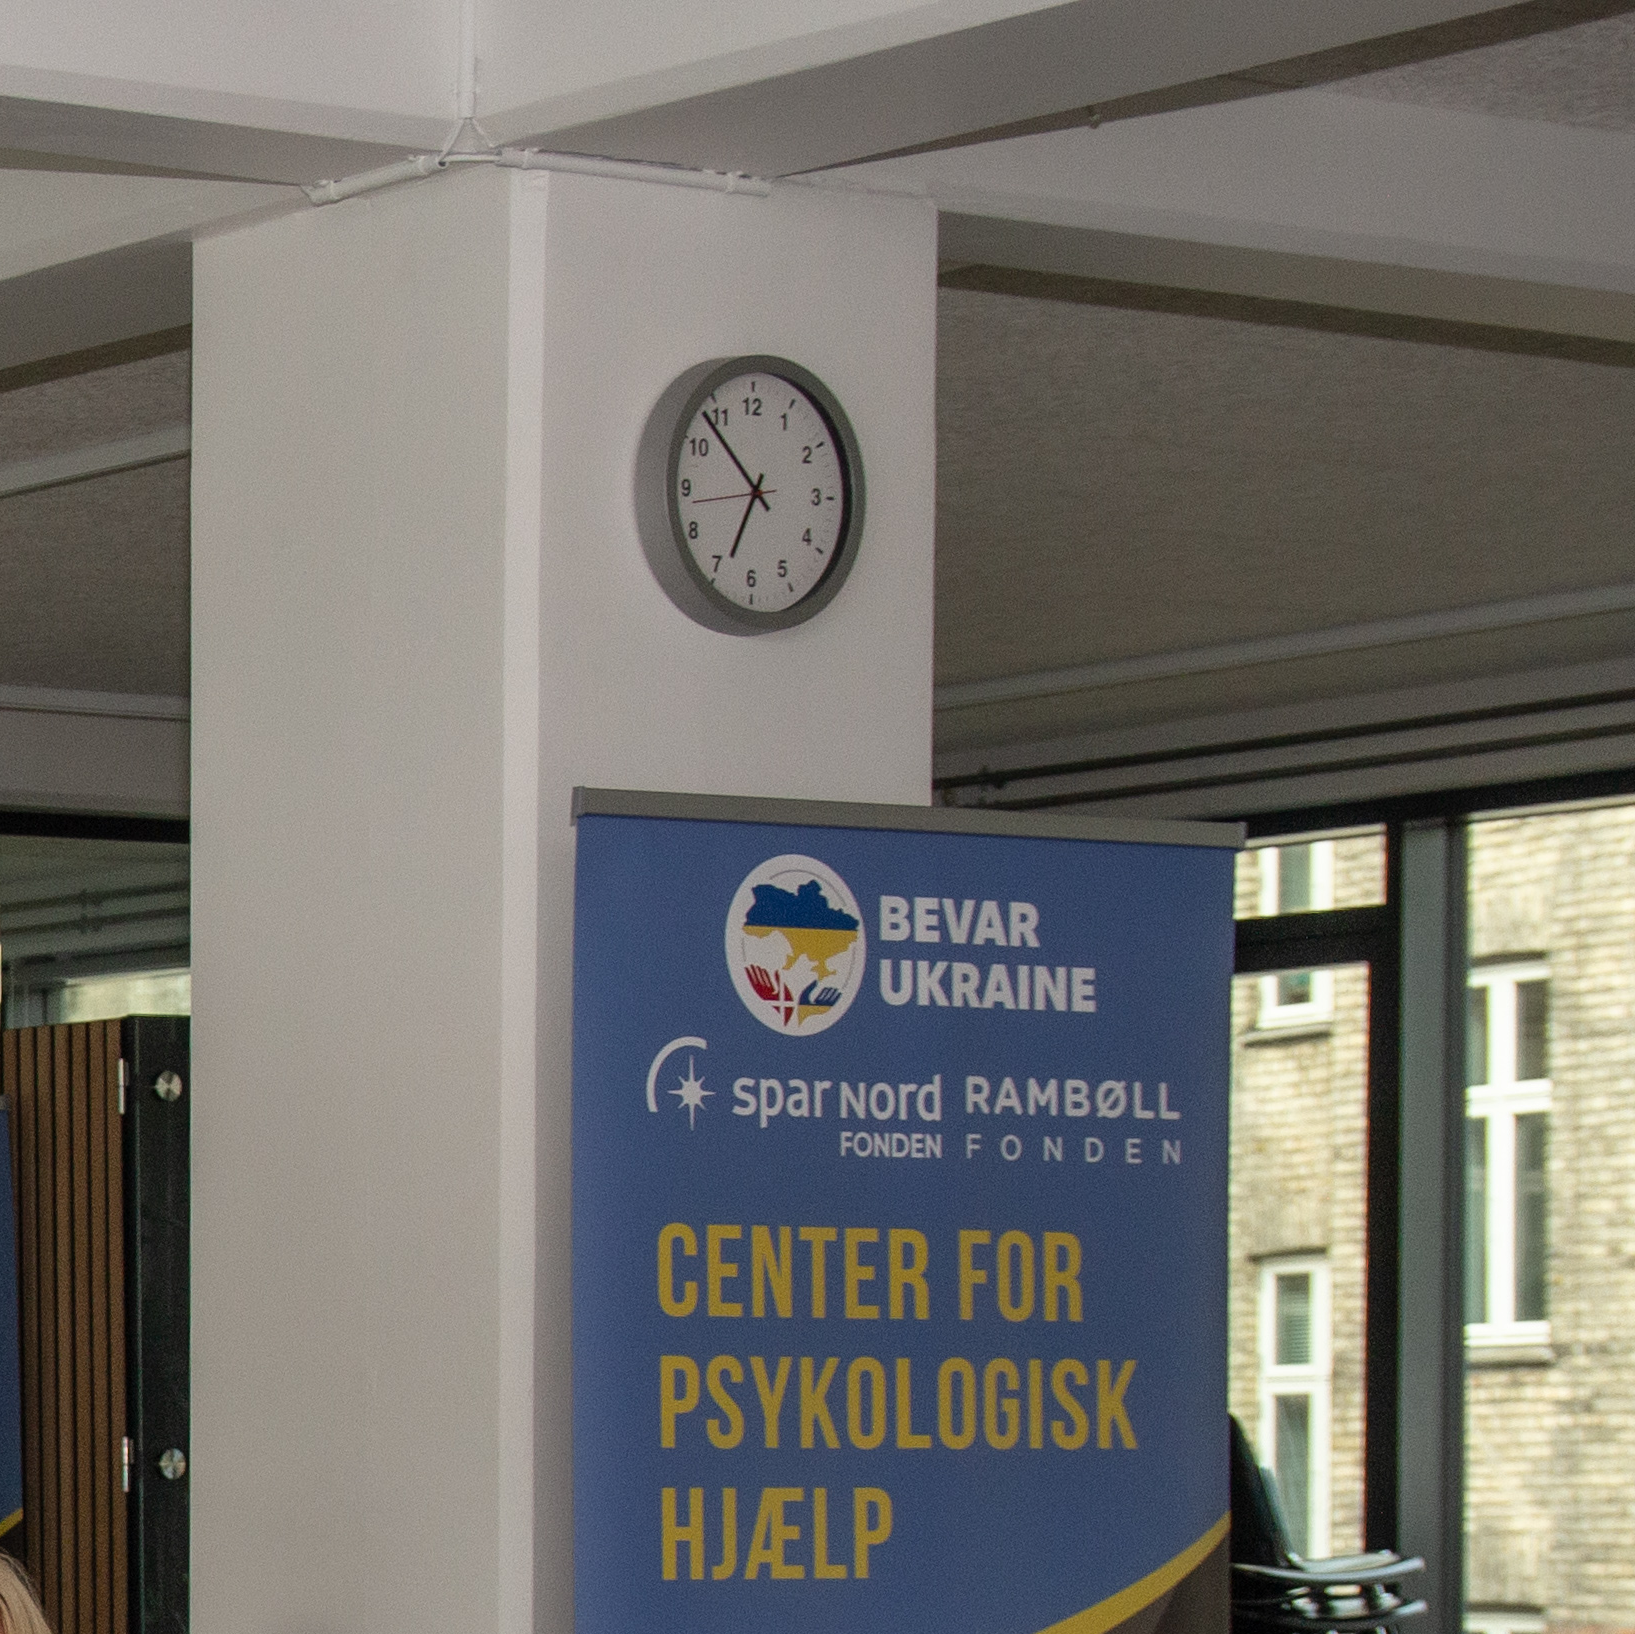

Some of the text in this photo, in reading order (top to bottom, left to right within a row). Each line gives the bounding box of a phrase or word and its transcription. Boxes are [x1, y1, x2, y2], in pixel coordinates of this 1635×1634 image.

[742, 397, 762, 416] 12
[780, 413, 788, 431] 1
[689, 438, 709, 457] 10
[802, 446, 813, 464] 2
[681, 478, 691, 497] 9
[811, 488, 822, 506] 3
[688, 521, 699, 540] 8
[802, 527, 813, 546] 4
[711, 555, 723, 573] 7
[777, 560, 788, 578] 5
[746, 570, 757, 588] 6
[879, 895, 1041, 948] BEVAR
[879, 958, 1097, 1013] UKRAINE
[965, 1075, 1181, 1121] RAMBØLL
[840, 1131, 943, 1159] FONDEN
[656, 1222, 1084, 1323] CENTER FOR
[658, 1354, 1139, 1451] PSYKOLOGISK
[660, 1486, 894, 1582] HJÆLP
